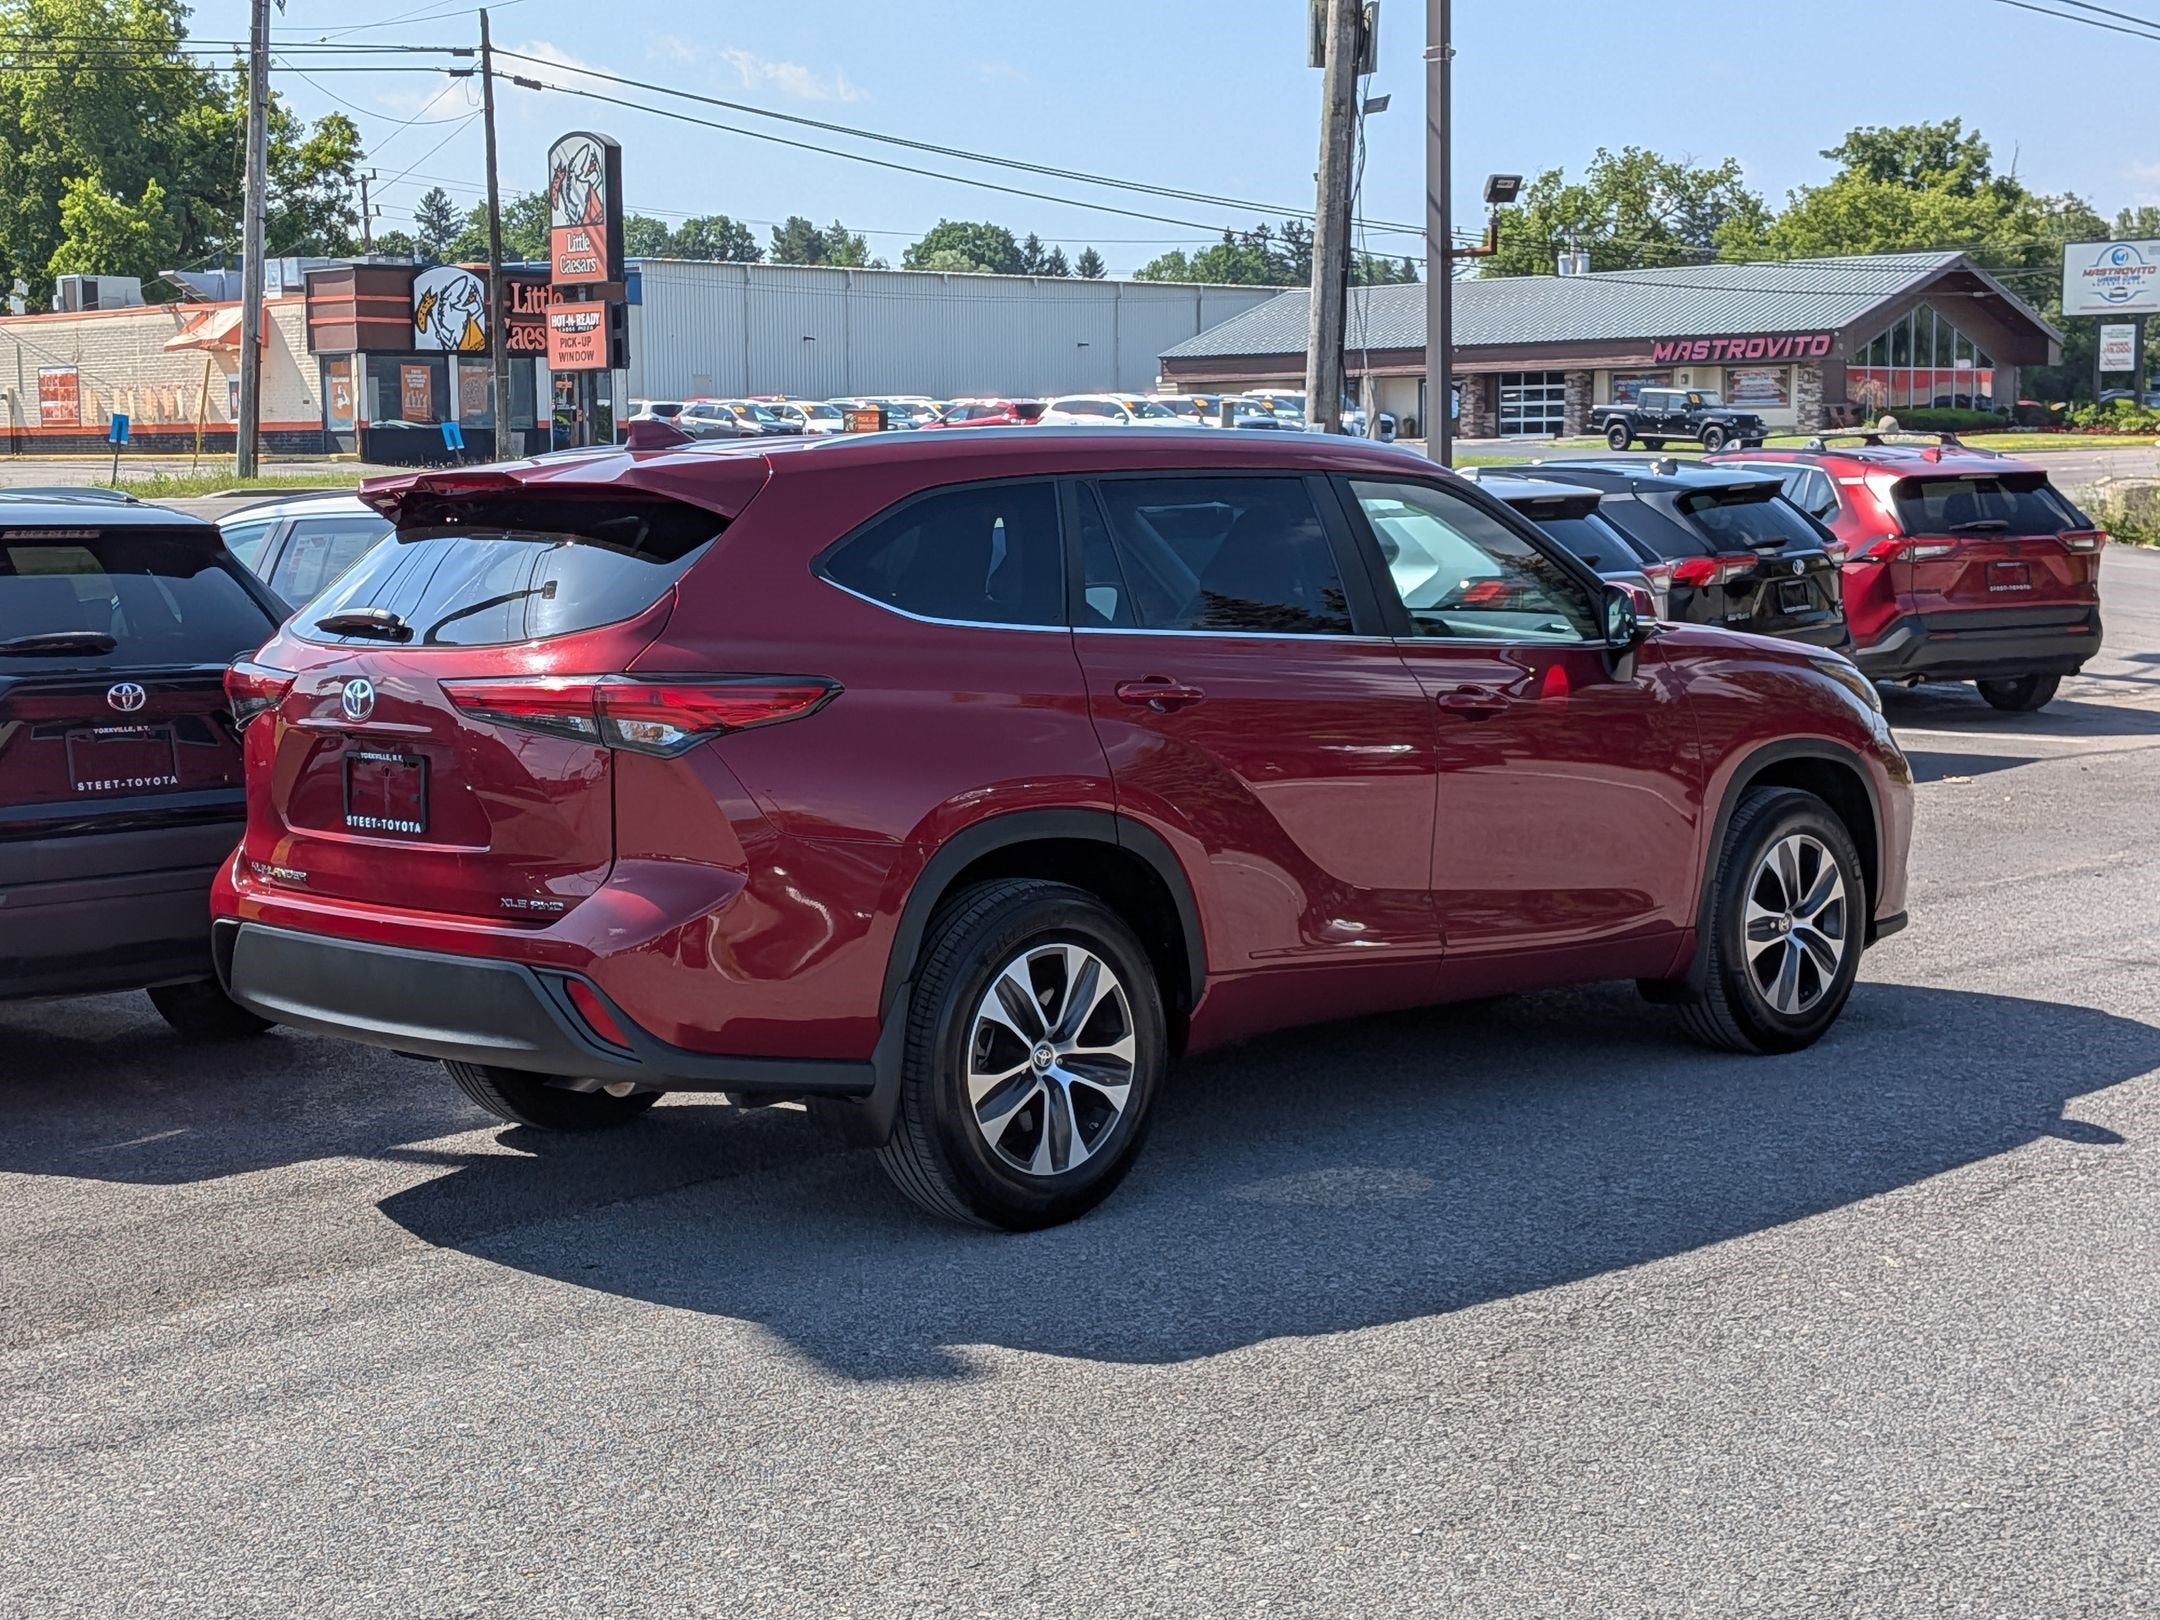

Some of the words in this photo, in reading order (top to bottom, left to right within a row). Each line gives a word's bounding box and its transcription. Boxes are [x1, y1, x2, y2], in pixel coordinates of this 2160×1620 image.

[566, 232, 591, 252] Little
[559, 254, 597, 274] Caesars
[2082, 265, 2157, 277] MASTROVITO
[551, 312, 600, 328] HOT-N-READY
[560, 336, 592, 348] PICK-UP
[1652, 334, 1831, 362] MASTROVITO
[558, 350, 595, 362] WINDOW
[77, 775, 179, 791] STEET-TOYOTA
[346, 815, 422, 833] STEET-TOYOTA
[500, 897, 527, 909] XLE
